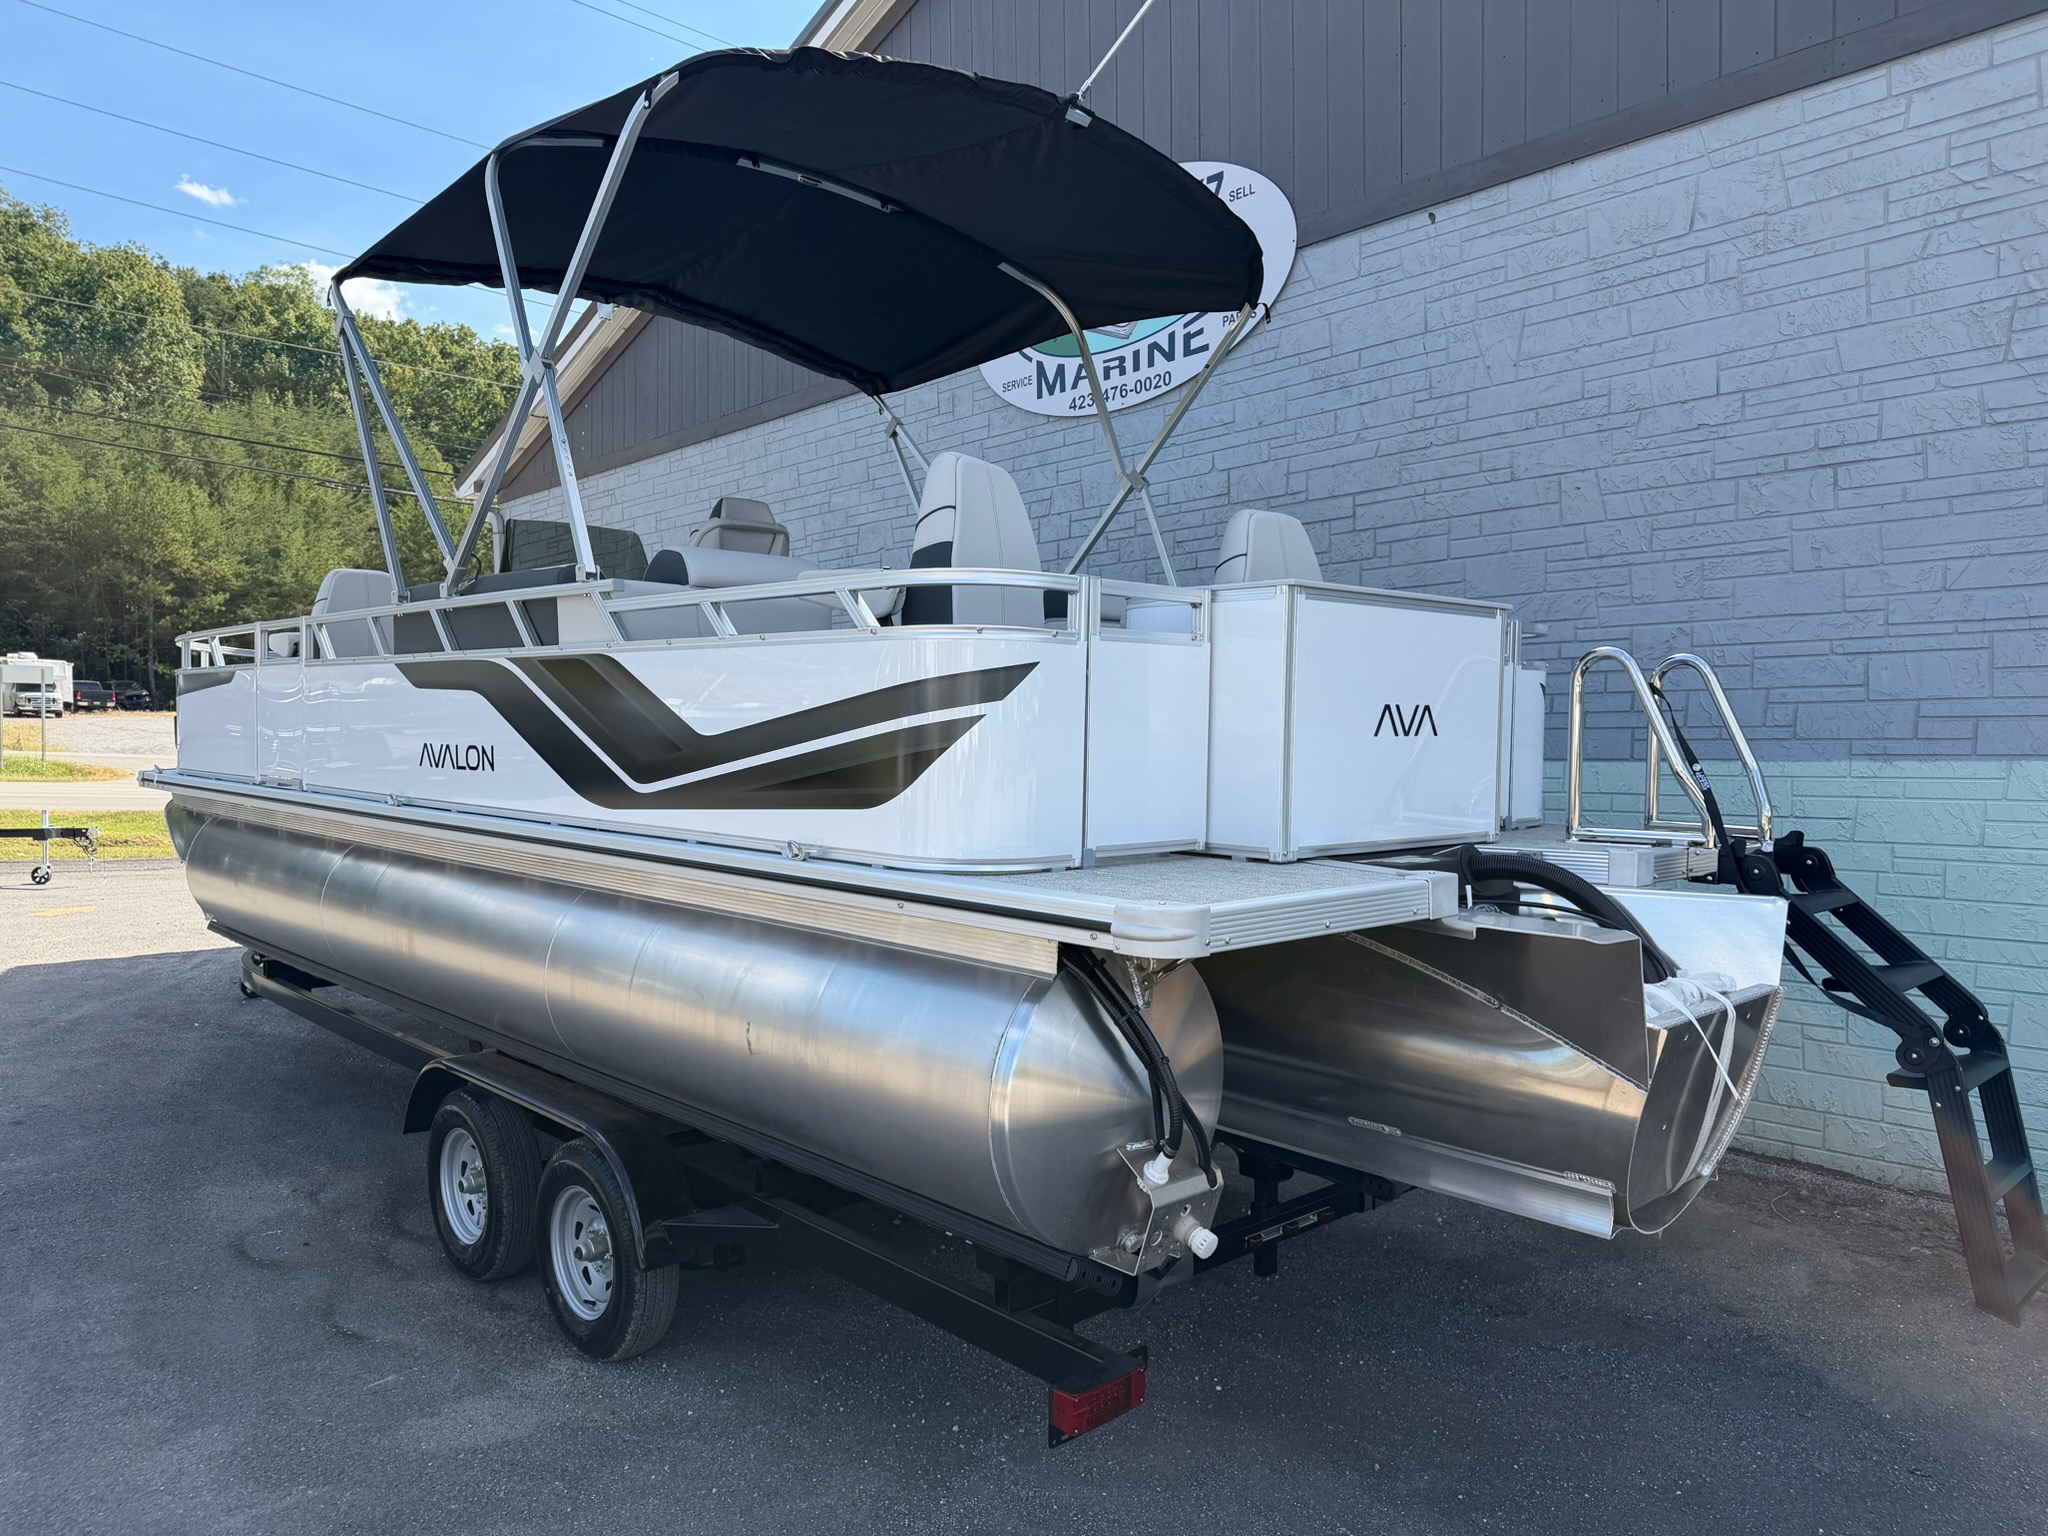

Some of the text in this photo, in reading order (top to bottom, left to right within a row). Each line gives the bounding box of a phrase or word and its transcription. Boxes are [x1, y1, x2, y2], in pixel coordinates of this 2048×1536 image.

[1228, 183, 1256, 203] SELL
[1036, 327, 1210, 400] MARINE
[1002, 375, 1033, 393] SERVICE
[1068, 371, 1172, 411] 423476-0020
[1373, 703, 1438, 737] AVA
[419, 742, 495, 772] AVALON
